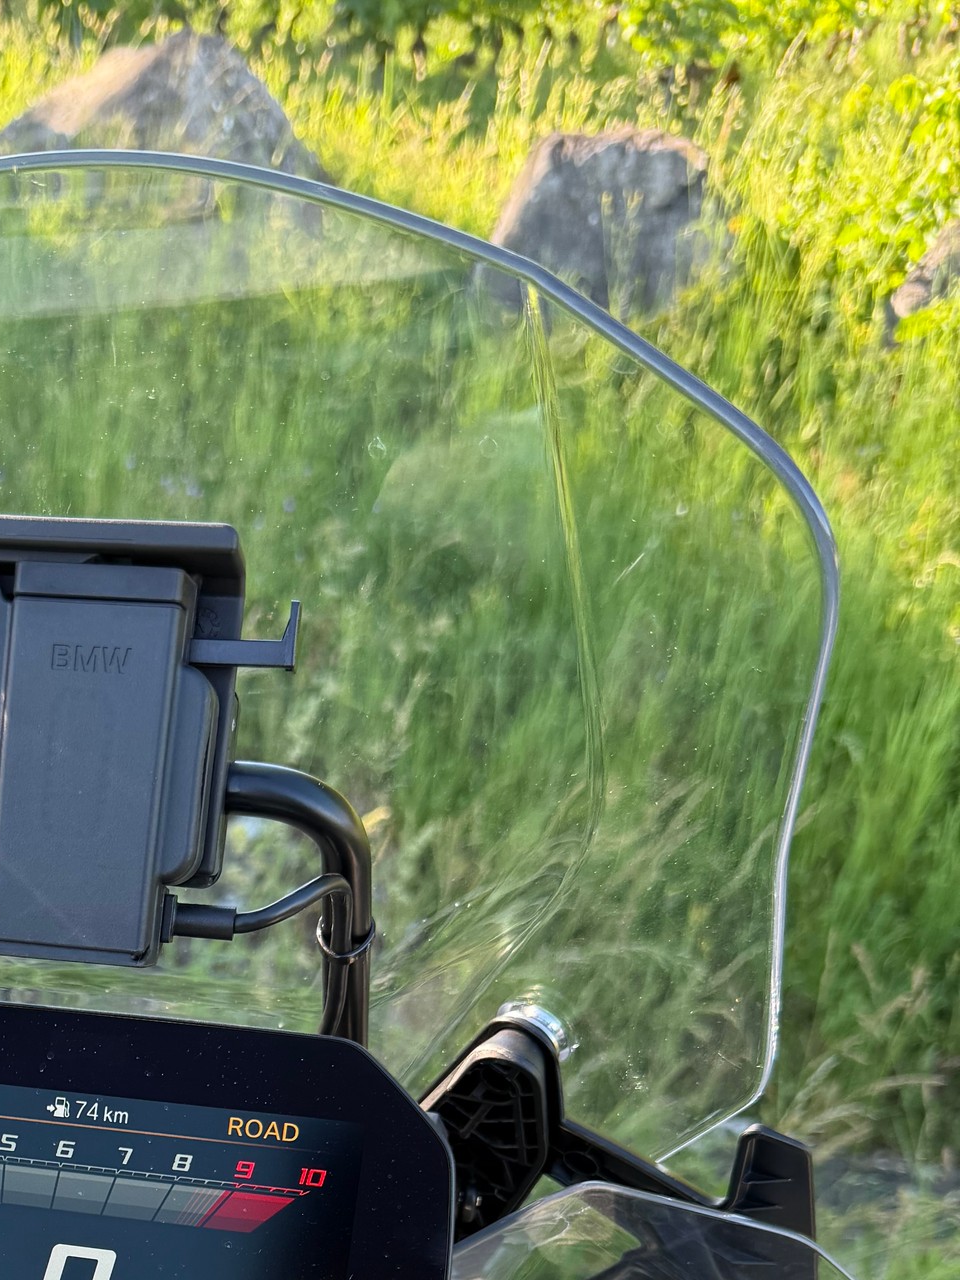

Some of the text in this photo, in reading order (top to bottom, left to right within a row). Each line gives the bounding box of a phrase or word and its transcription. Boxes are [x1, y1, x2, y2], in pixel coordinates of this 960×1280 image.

[51, 643, 132, 674] BMW
[75, 1101, 129, 1124] 74 km
[227, 1117, 299, 1142] ROAD
[0, 1134, 19, 1152] 5
[55, 1140, 76, 1158] 6
[117, 1147, 134, 1165] 7
[172, 1154, 193, 1172] 8
[234, 1161, 255, 1179] 9
[299, 1167, 327, 1187] 10
